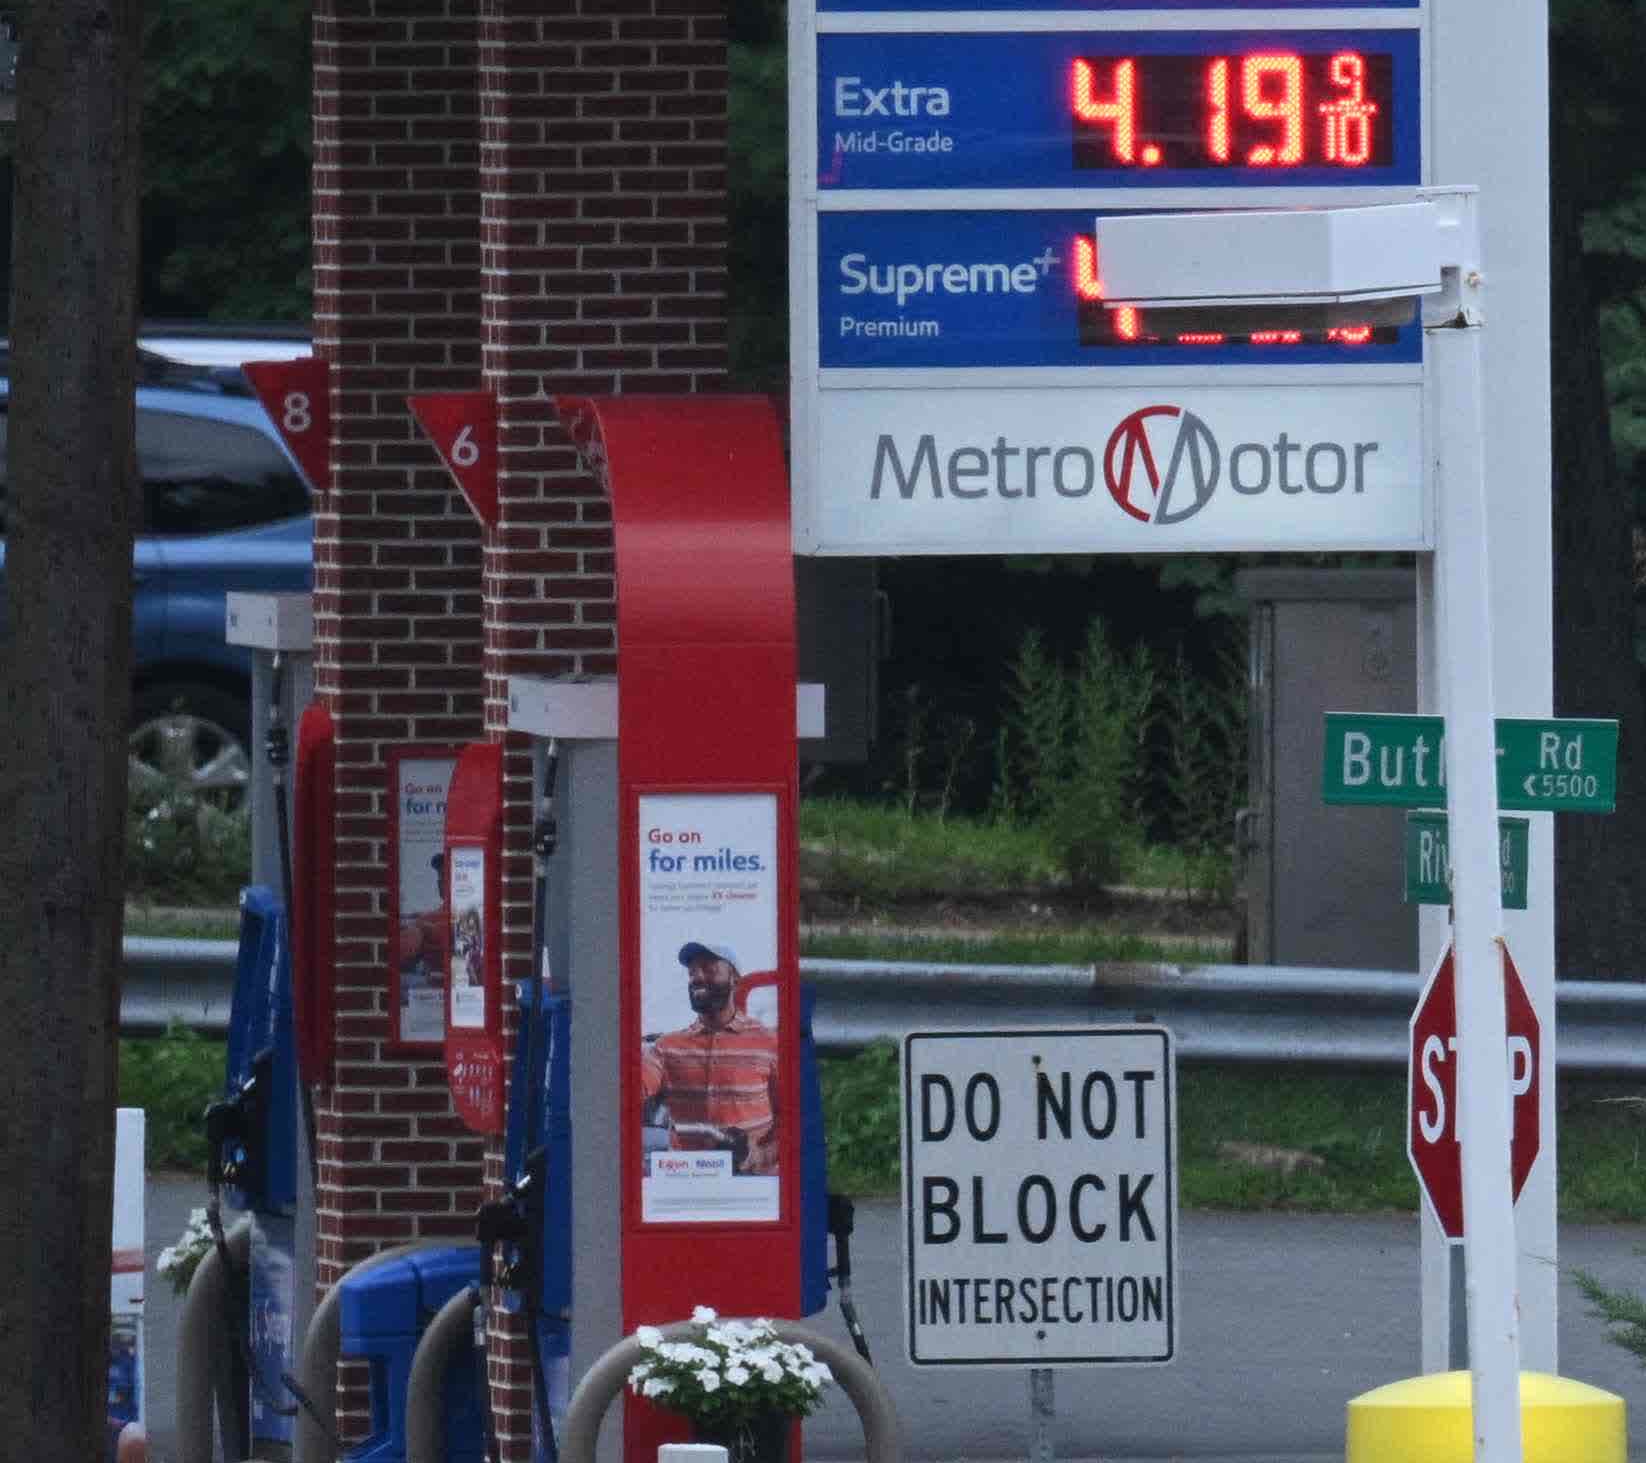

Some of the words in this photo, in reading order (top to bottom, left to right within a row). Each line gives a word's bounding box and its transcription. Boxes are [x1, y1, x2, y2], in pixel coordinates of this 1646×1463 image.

[834, 76, 951, 117] Extra
[1071, 53, 1303, 165] 4.19
[834, 131, 954, 155] Mid-Grade
[839, 316, 940, 337] Premium
[283, 392, 311, 433] 8
[451, 425, 479, 467] 6
[1540, 731, 1582, 770] Rd
[648, 828, 673, 844] Go
[678, 831, 701, 844] on
[648, 848, 687, 872] for
[693, 847, 766, 872] miles.
[920, 1072, 1000, 1142] DO
[1036, 1070, 1155, 1141] NOT
[922, 1173, 1157, 1245] BLOCK
[919, 1276, 1163, 1325] INTERSECTION
